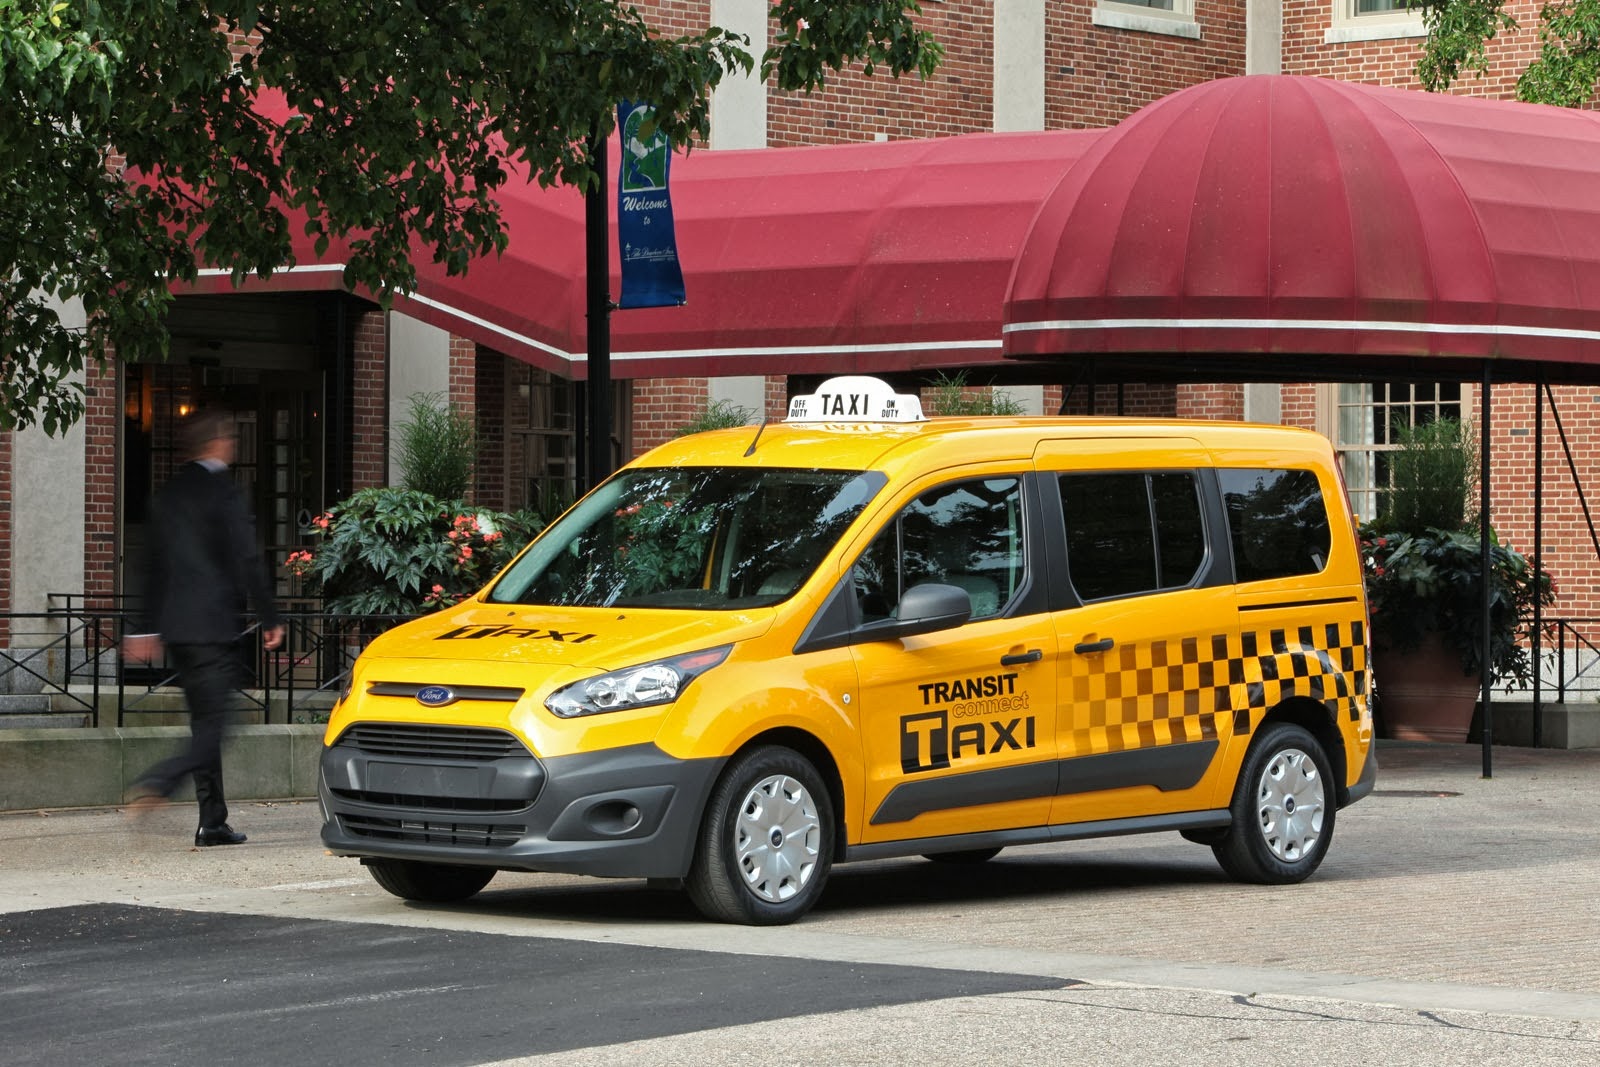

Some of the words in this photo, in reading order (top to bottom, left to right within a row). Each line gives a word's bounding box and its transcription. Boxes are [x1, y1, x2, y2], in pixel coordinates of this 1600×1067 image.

[623, 196, 667, 211] Welcome
[643, 216, 650, 225] to
[795, 399, 806, 408] OFF
[821, 393, 869, 415] TAXI
[886, 399, 895, 408] ON
[791, 408, 807, 417] DUTY
[881, 408, 898, 417] DUTY
[433, 624, 598, 643] TAXI
[422, 689, 443, 699] Ford
[918, 673, 1018, 704] TRANSIT
[952, 691, 1029, 718] connect
[900, 710, 1035, 774] TAXI
